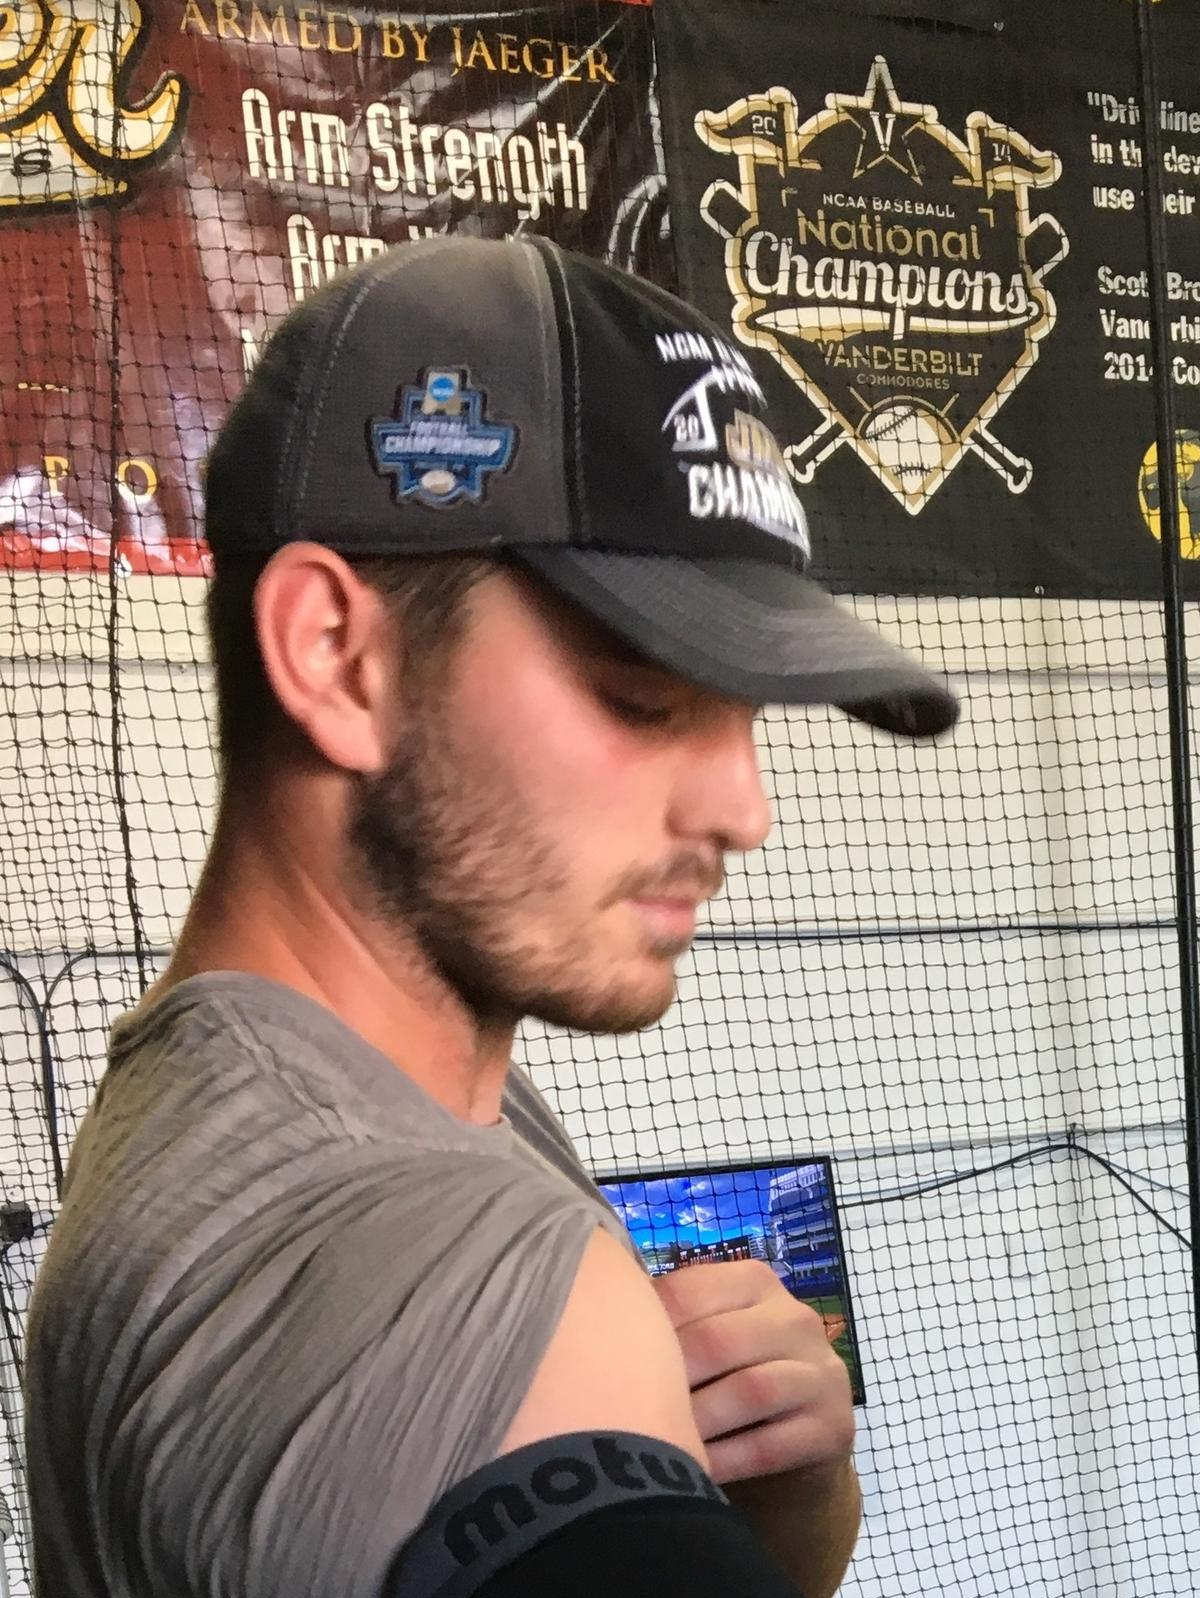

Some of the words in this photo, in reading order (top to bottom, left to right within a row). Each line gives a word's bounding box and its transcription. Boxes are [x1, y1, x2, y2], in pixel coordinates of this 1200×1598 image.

[180, 0, 362, 52] ARMED
[382, 18, 429, 61] BY
[451, 24, 617, 84] JAEGER
[751, 115, 776, 136] 20
[241, 88, 349, 187] Arm
[366, 102, 588, 221] Strength
[1091, 133, 1113, 165] in
[1119, 138, 1143, 168] th
[823, 193, 867, 210] NCAA
[872, 198, 955, 219] BASEBALL
[1093, 186, 1136, 211] use
[796, 208, 982, 261] National
[744, 230, 1040, 341] Champions
[1097, 265, 1150, 298] Scot
[816, 341, 983, 377] VANDERBILT
[1103, 351, 1154, 382] 201
[856, 373, 951, 391] COMMODORES
[443, 1437, 730, 1566] motu
